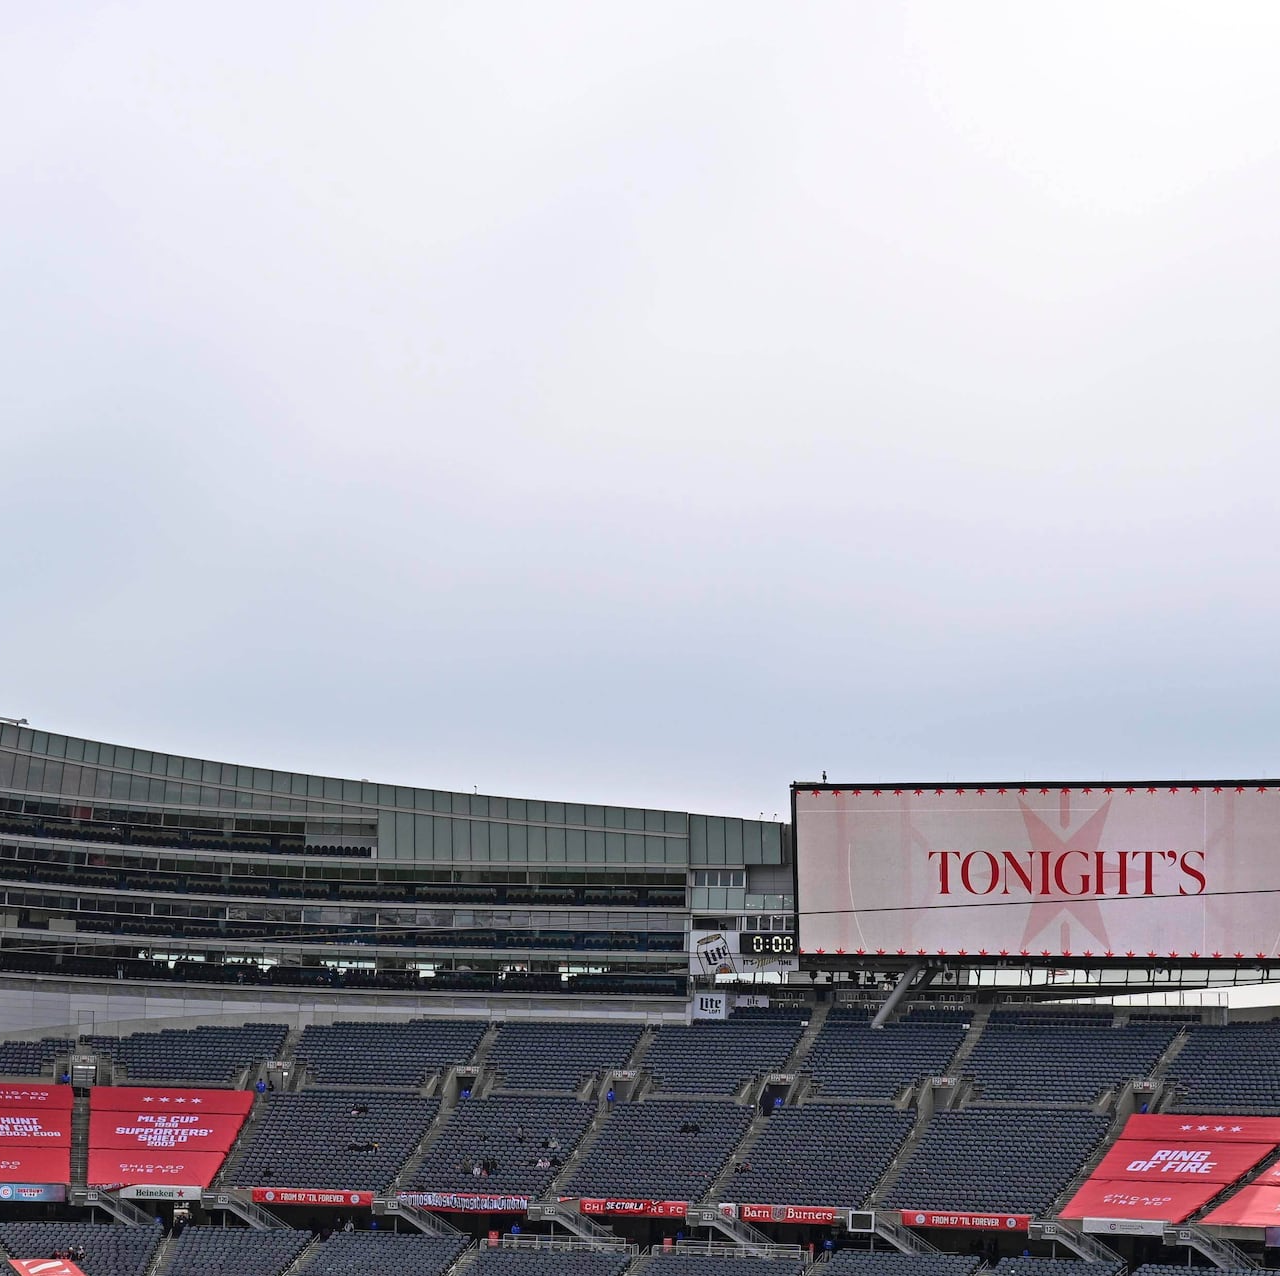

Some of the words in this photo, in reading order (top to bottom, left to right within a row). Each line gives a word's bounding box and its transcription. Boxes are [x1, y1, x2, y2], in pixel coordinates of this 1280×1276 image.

[929, 850, 1206, 896] TONIGHT'S
[753, 936, 793, 953] 0:00
[703, 944, 727, 966] Lite
[700, 997, 721, 1011] Lite
[1, 1117, 38, 1126] HUNT
[137, 1115, 171, 1123] MLS
[174, 1115, 199, 1124] CUP
[115, 1127, 214, 1137] SUPPORTERS'
[137, 1134, 188, 1143] SHIELD
[1152, 1150, 1211, 1161] RING
[1126, 1160, 1161, 1172] OF
[1162, 1161, 1218, 1174] FIRE
[135, 1189, 174, 1198] Heineken
[281, 1193, 297, 1201] FROM
[319, 1194, 344, 1203] FOREVER
[744, 1205, 770, 1218] Barn
[787, 1207, 833, 1221] Burners
[932, 1217, 949, 1225] FROM
[971, 1218, 999, 1227] FOREVER
